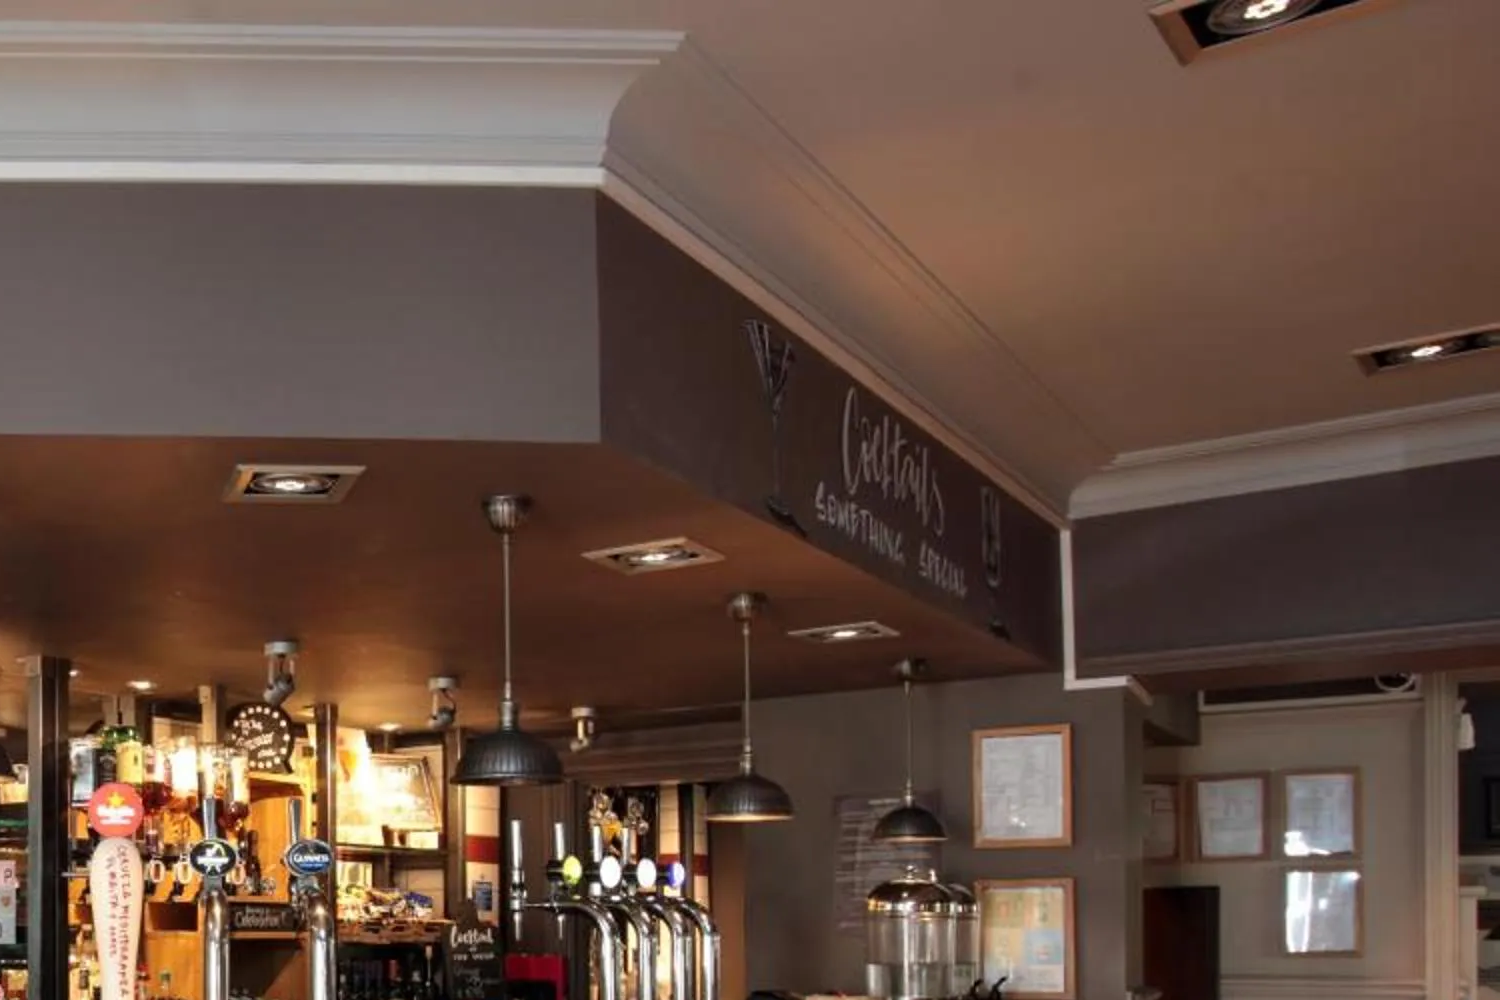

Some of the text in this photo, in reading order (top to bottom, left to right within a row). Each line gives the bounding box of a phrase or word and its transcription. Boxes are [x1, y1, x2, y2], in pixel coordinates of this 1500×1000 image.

[842, 387, 944, 537] Cocktails
[815, 479, 968, 598] SOMETHING SPECIAL
